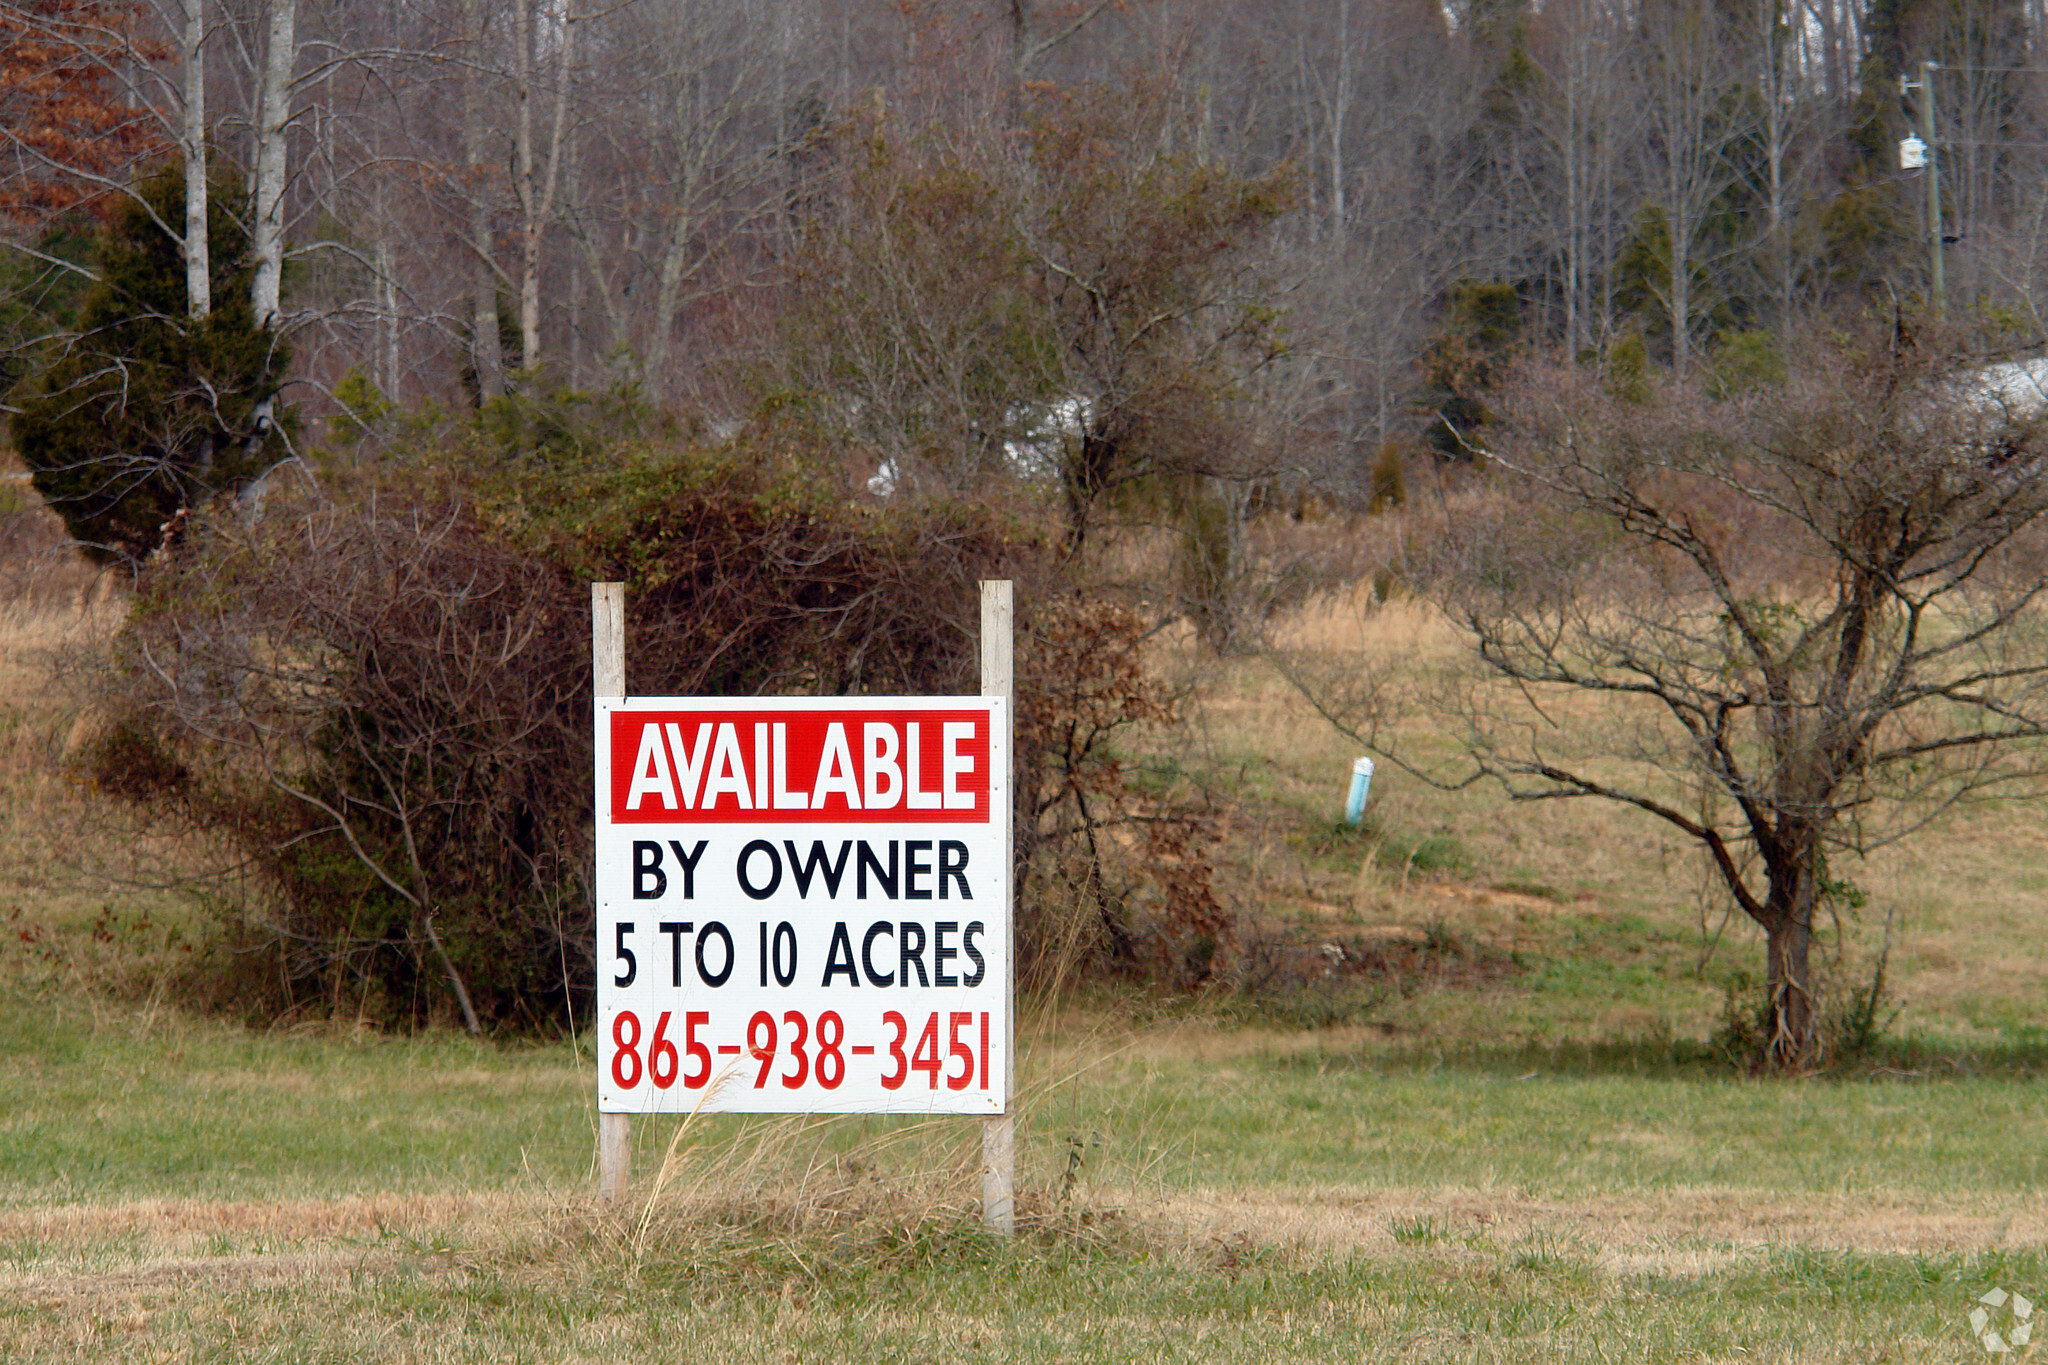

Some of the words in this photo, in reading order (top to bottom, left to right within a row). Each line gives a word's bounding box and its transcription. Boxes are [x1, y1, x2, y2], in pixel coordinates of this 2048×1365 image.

[626, 722, 976, 810] AVAILABLE
[632, 840, 710, 900] BY
[736, 839, 974, 900] OWNER
[613, 921, 637, 988] 5
[659, 920, 735, 988] TO
[759, 921, 798, 988] 10
[821, 920, 986, 988] ACRES
[611, 1010, 990, 1091] 865-938-3451
